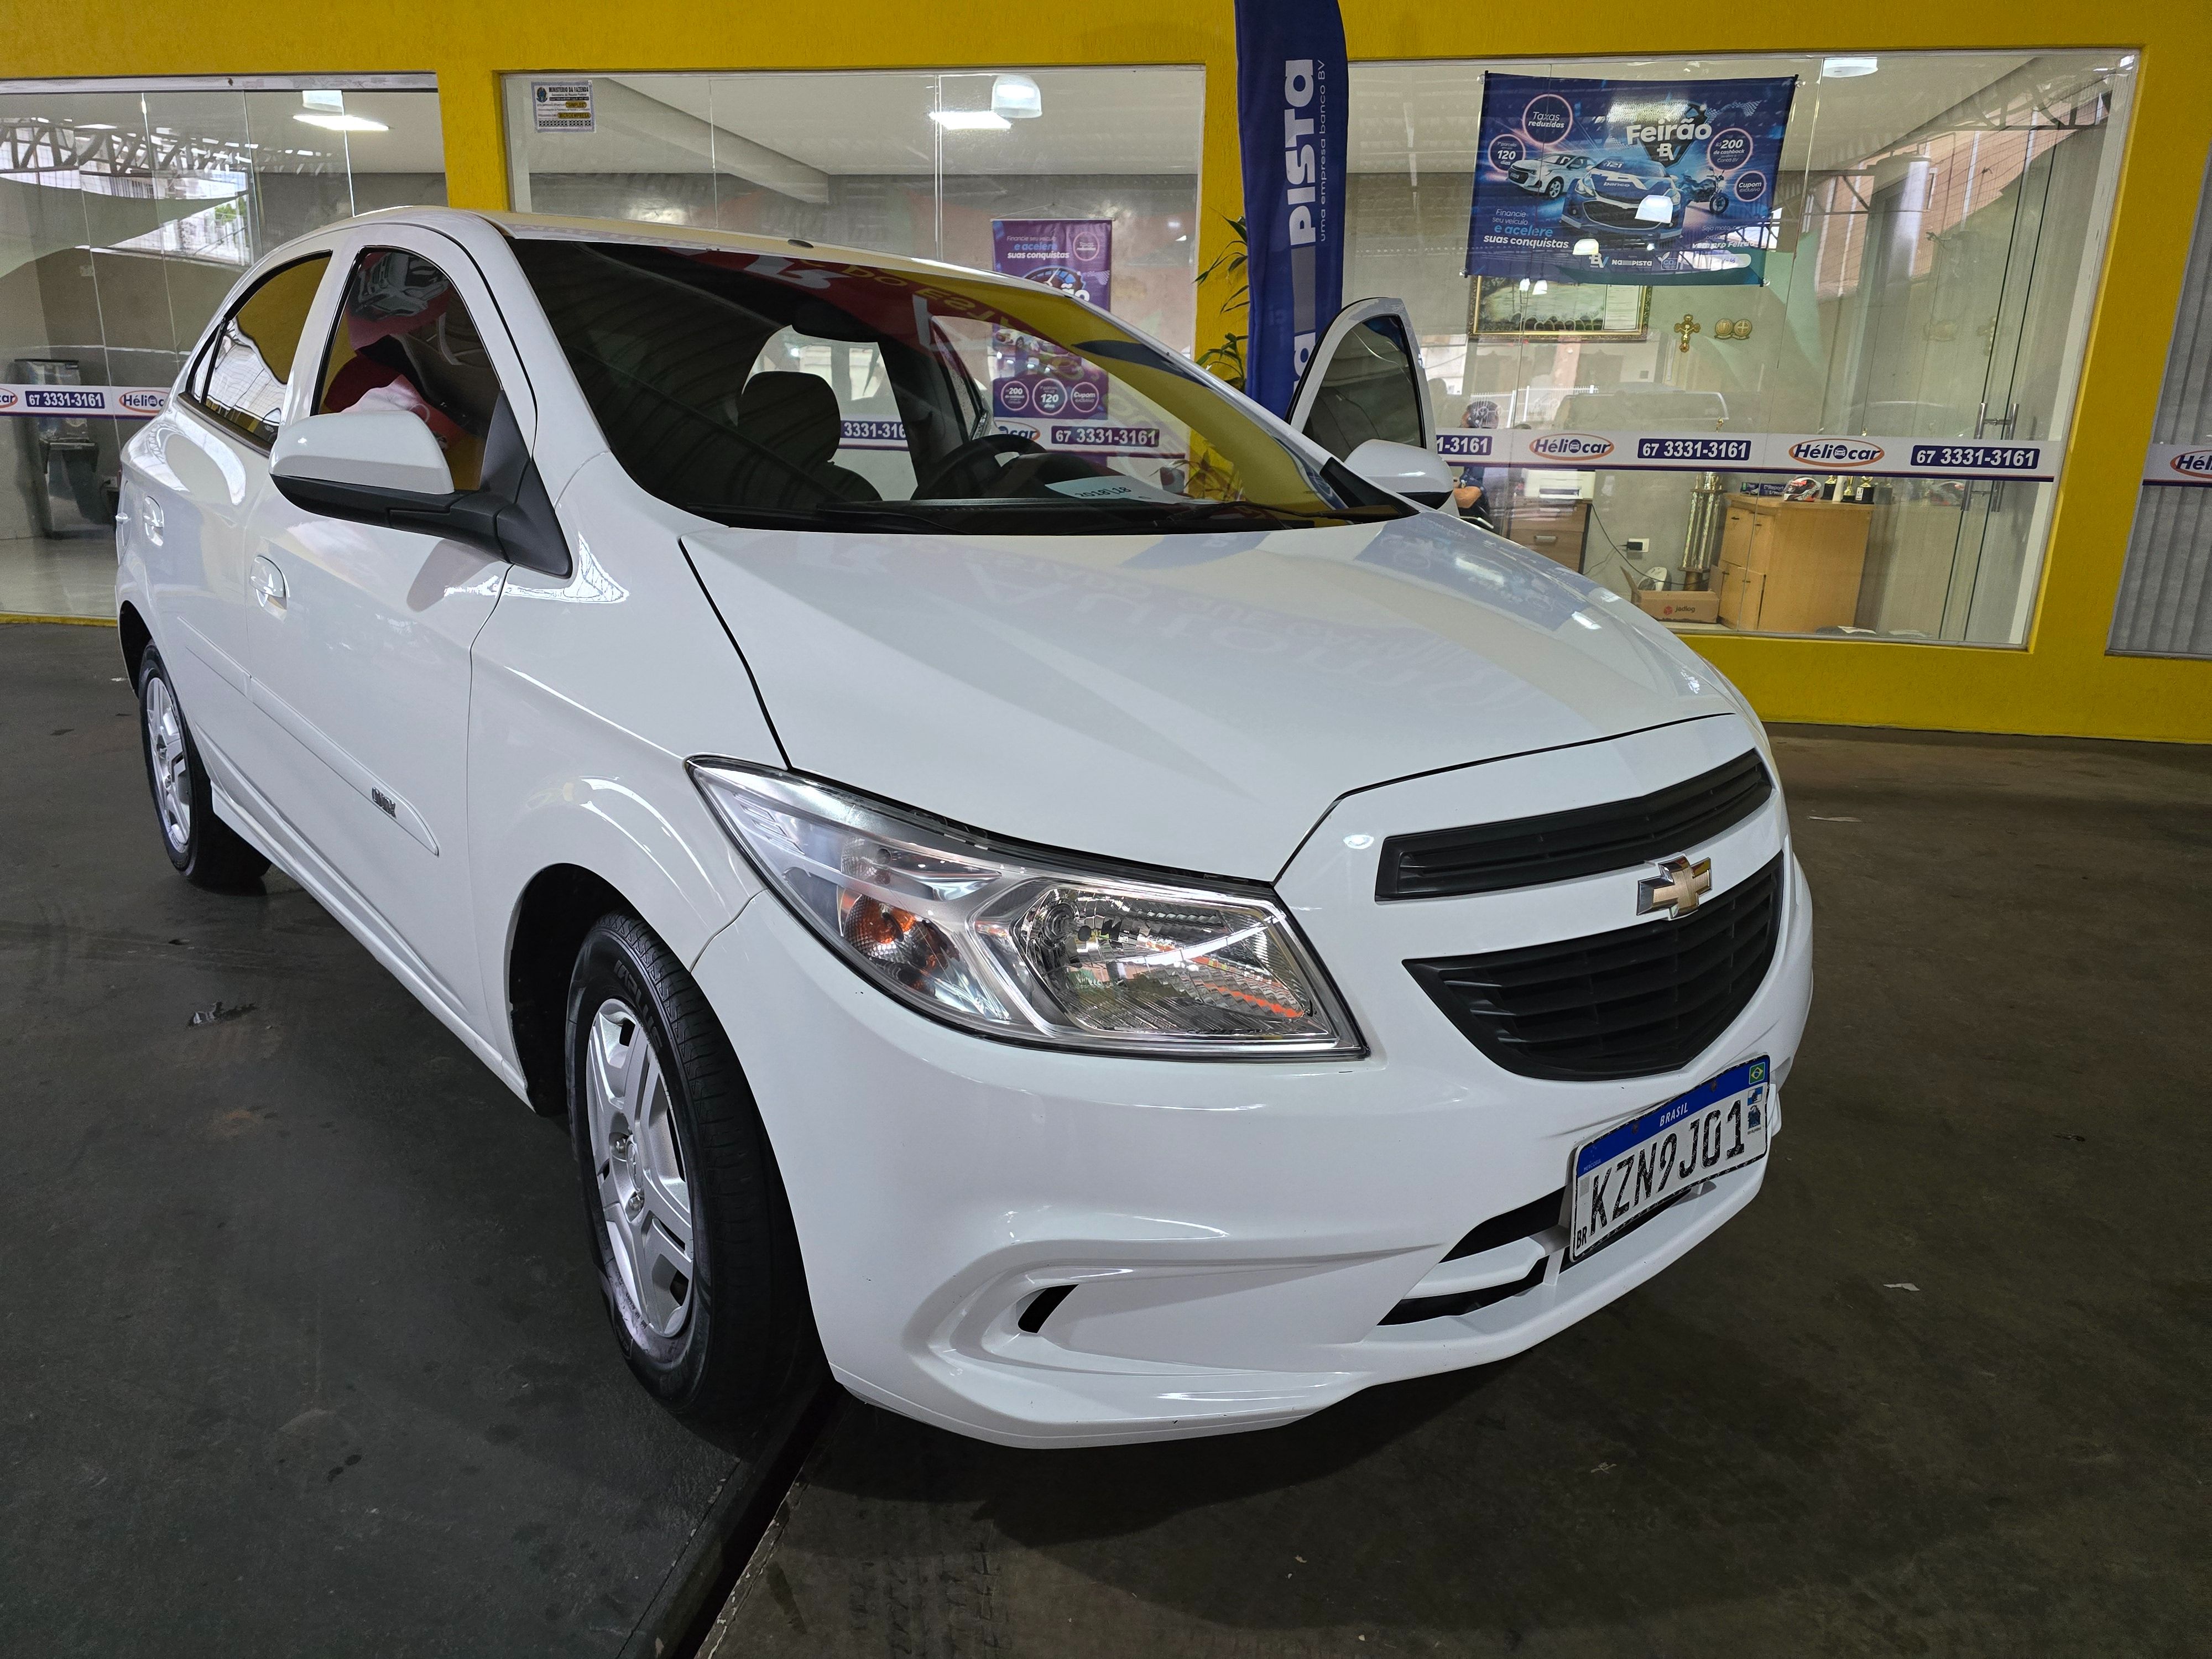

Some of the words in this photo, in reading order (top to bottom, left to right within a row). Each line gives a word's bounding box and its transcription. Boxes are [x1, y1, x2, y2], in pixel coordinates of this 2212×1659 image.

[1318, 59, 1326, 80] BV
[1533, 111, 1560, 121] Taxas
[1528, 120, 1565, 128] reduzidas
[1626, 118, 1712, 145] Feirão
[1720, 139, 1744, 149] 200
[1497, 150, 1516, 160] 120
[1496, 208, 1526, 217] Financie
[1505, 217, 1528, 226] veículo
[1494, 224, 1502, 233] e
[1505, 225, 1554, 238] acelere
[1483, 234, 1509, 244] suas
[1026, 251, 1070, 260] conquistas
[29, 394, 40, 406] 67
[43, 392, 103, 407] 3331-3161
[1040, 394, 1059, 403] 120
[1056, 429, 1072, 442] 67
[1076, 428, 1157, 445] 3331-3161
[1642, 443, 1660, 457] 67
[1663, 441, 1747, 458] 3331-3161
[1916, 450, 1936, 464] 67
[1940, 448, 2036, 467] 3331-3161
[1659, 1102, 1688, 1127] BRASIL
[1589, 1099, 1745, 1237] KZN9J01
[1576, 1225, 1588, 1250] BR
